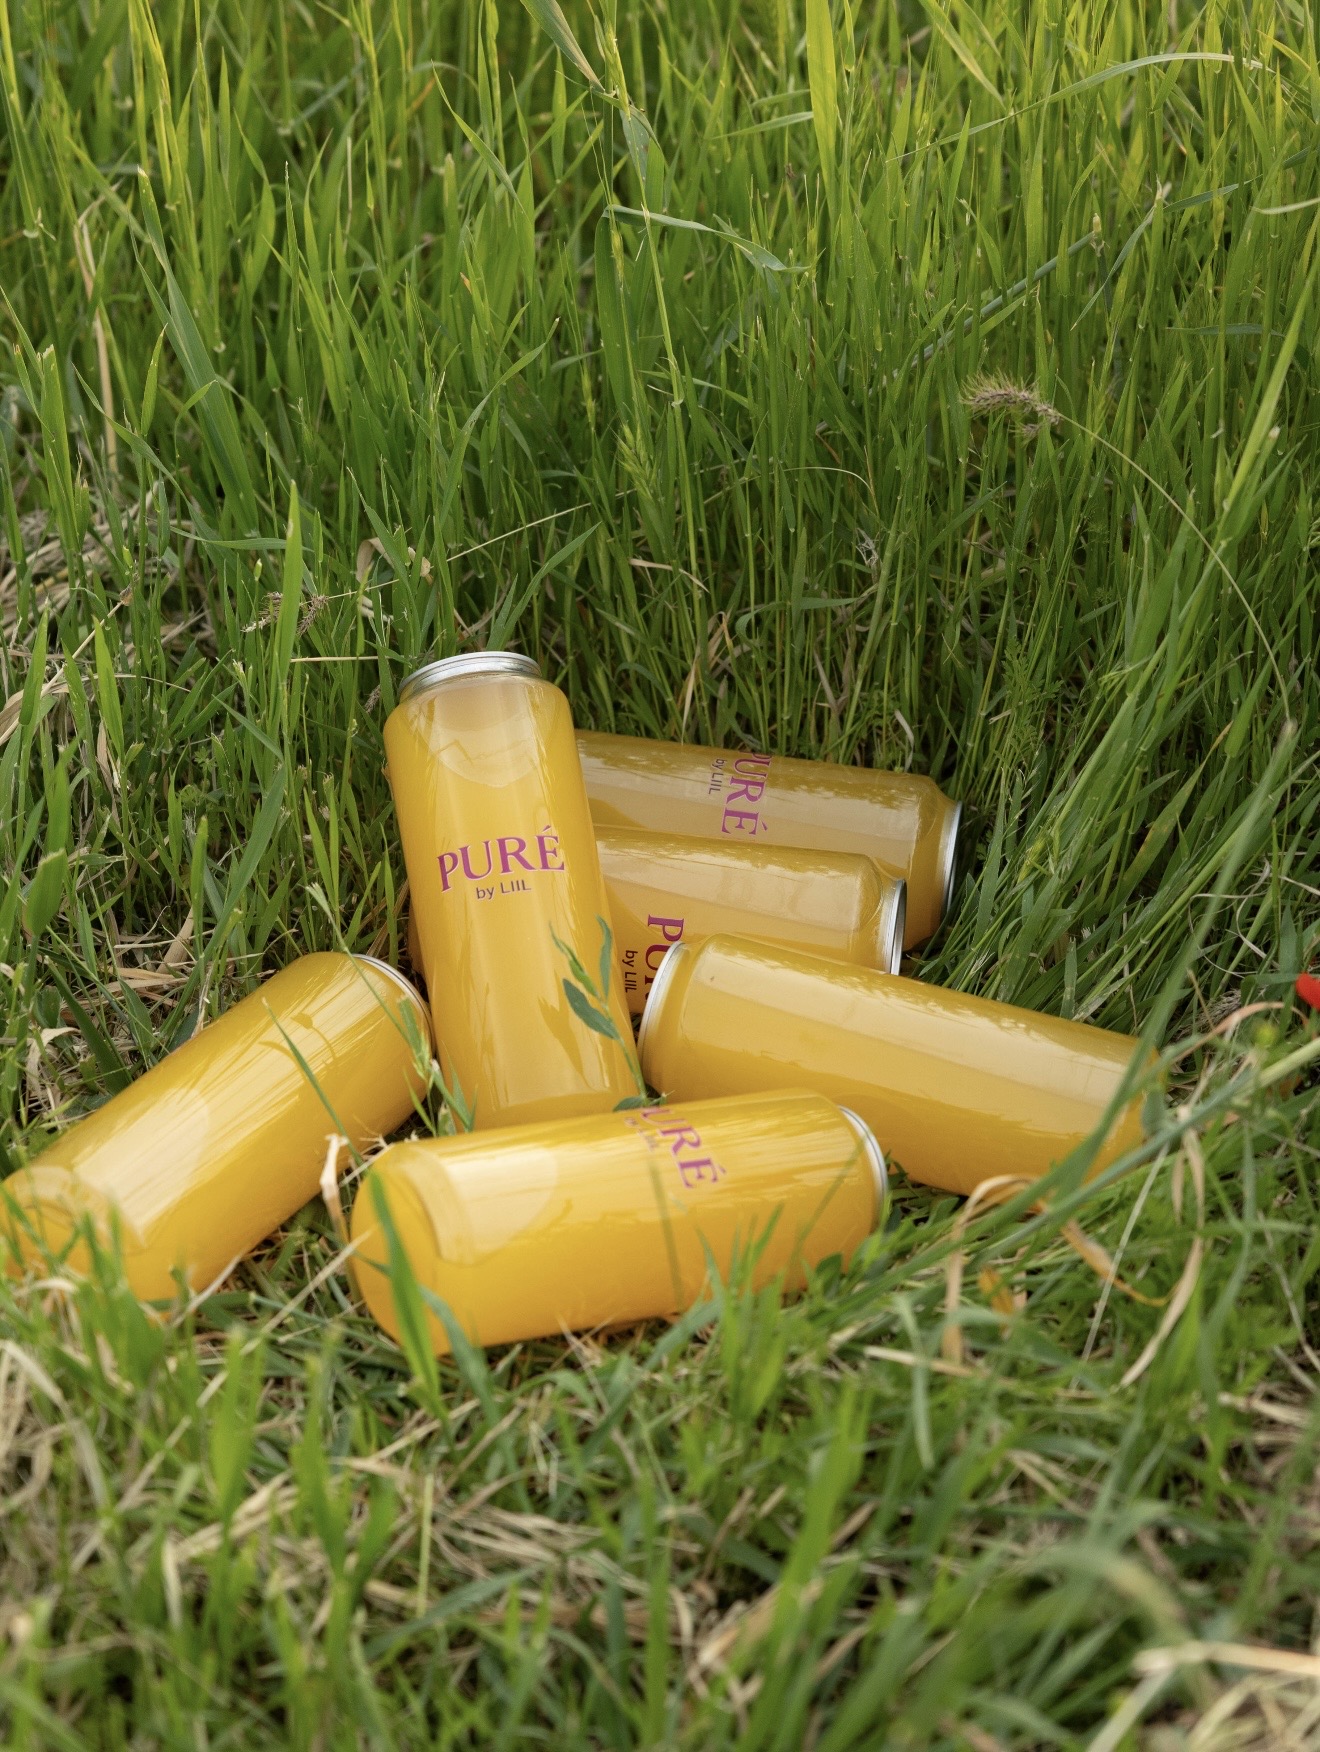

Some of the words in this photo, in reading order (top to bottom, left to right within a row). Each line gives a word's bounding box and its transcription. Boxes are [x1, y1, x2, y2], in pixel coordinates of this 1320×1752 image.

[711, 758, 727, 770] by
[708, 772, 724, 795] LIIL
[437, 824, 565, 893] PURÉ
[476, 886, 495, 900] by
[500, 879, 531, 894] LIIL
[622, 949, 638, 968] by
[644, 914, 685, 1000] PU
[624, 971, 637, 993] LIIL
[639, 1106, 727, 1188] URÉ
